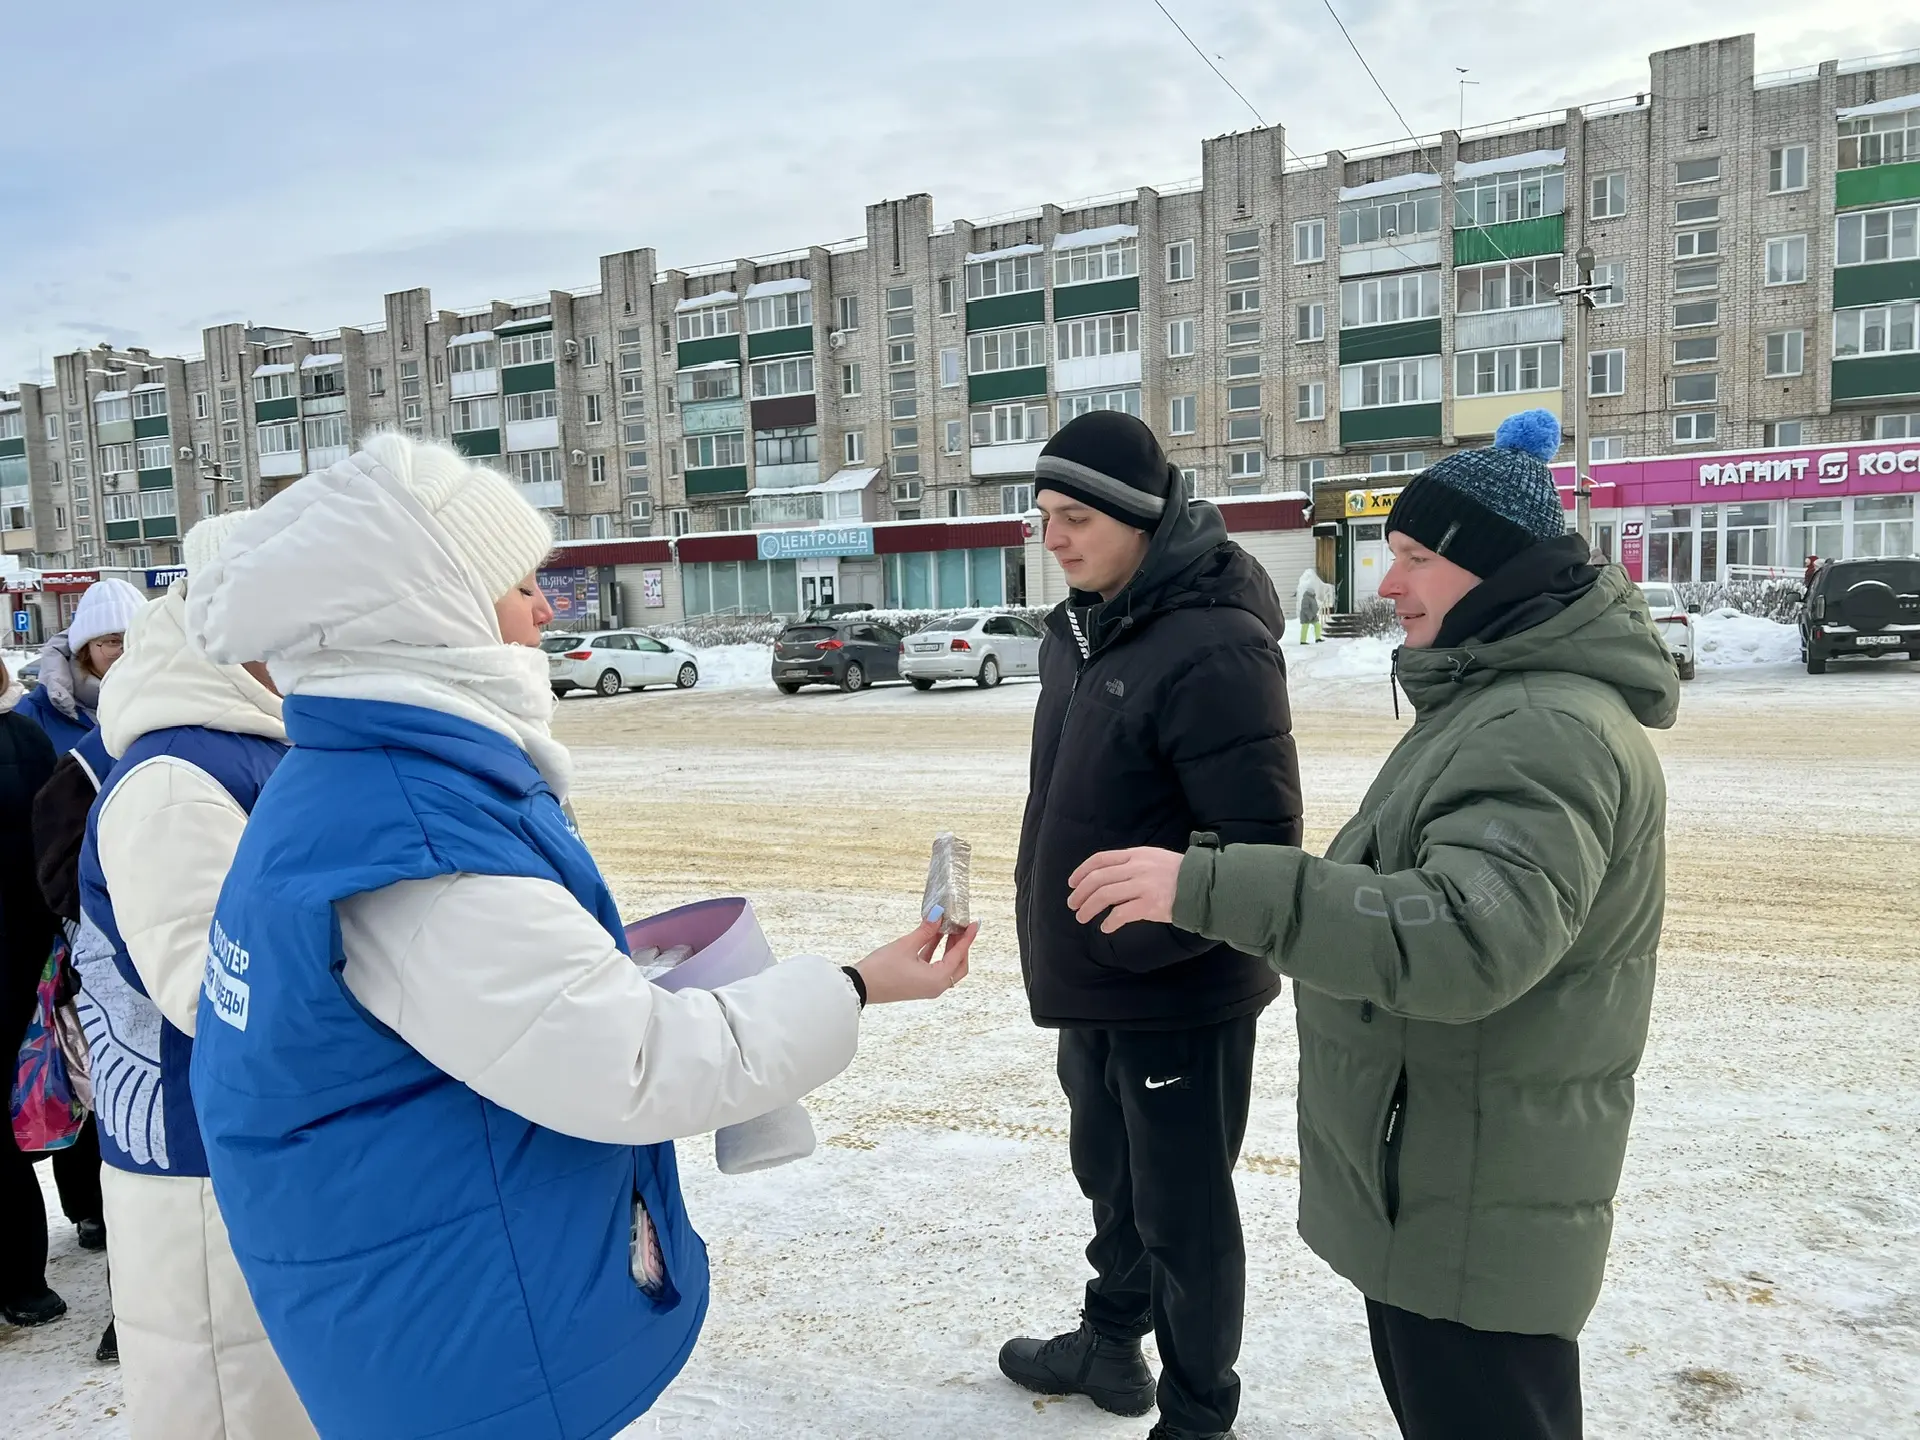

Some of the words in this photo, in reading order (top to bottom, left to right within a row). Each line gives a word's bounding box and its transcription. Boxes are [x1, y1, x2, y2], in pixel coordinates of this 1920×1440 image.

[1700, 458, 1809, 486] МАГНИТ
[1858, 450, 1920, 475] КОС
[781, 531, 868, 550] ЦЕНТРОМЕД
[17, 613, 27, 630] P
